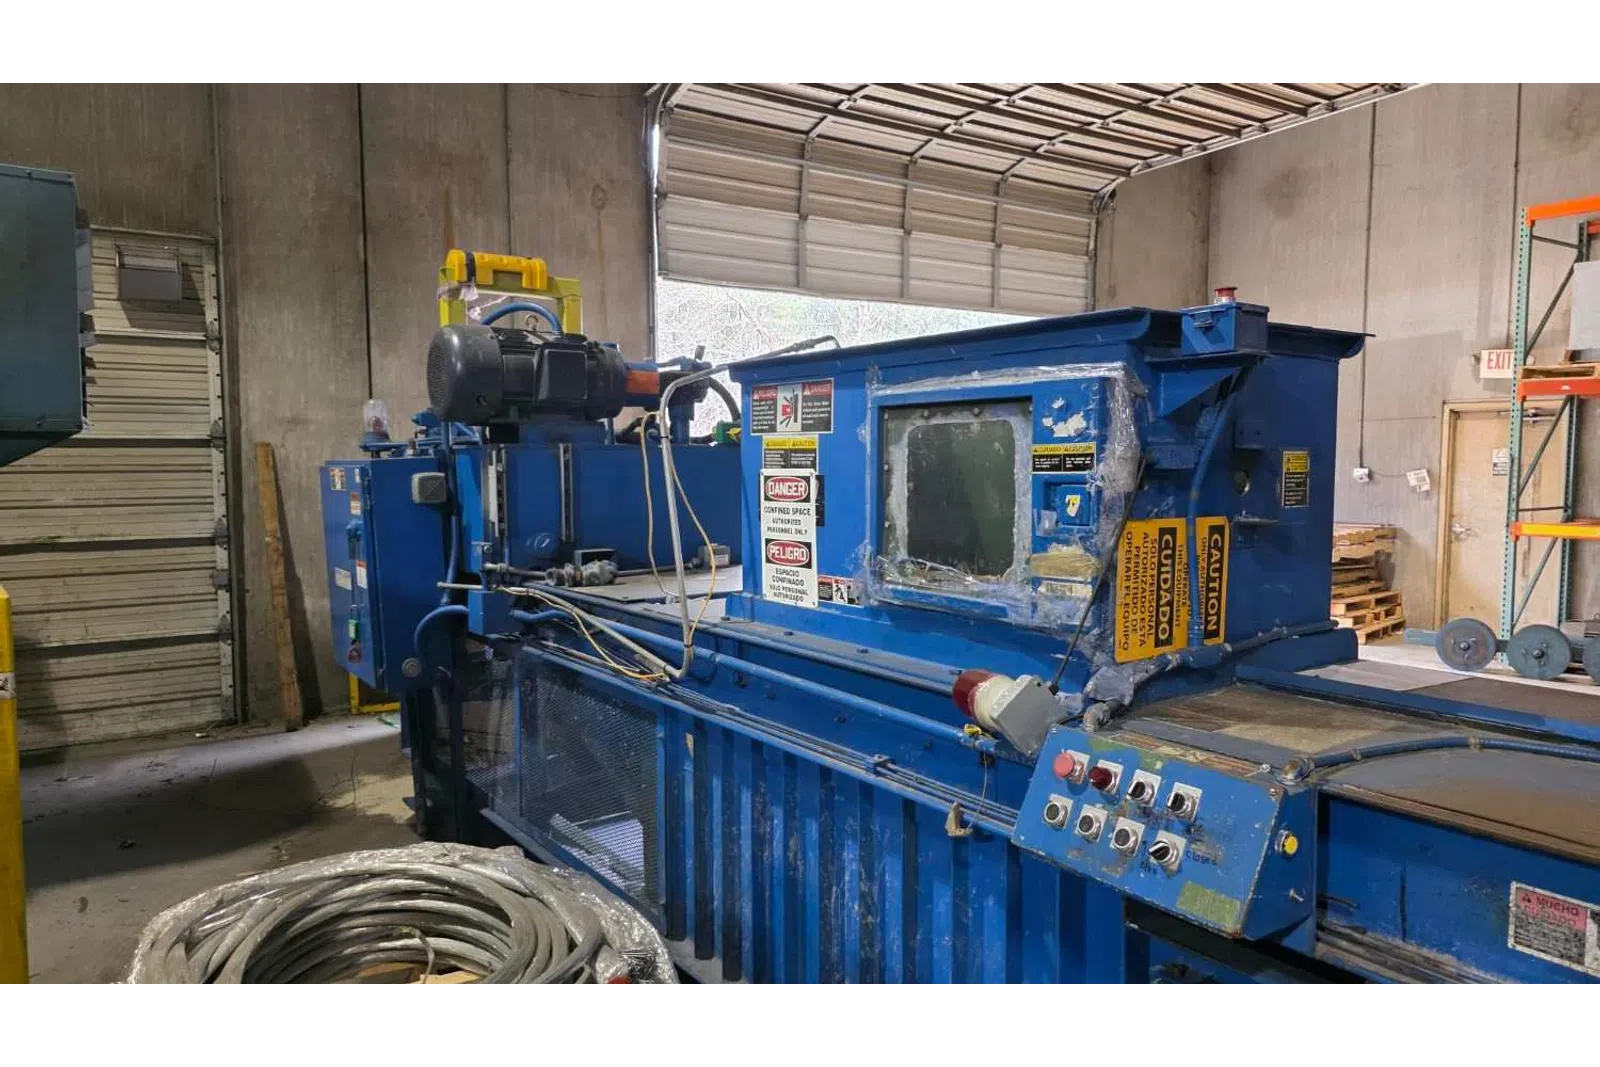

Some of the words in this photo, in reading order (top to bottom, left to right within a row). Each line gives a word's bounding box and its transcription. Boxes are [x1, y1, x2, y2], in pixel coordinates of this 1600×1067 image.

[1487, 351, 1512, 370] EXIT
[767, 482, 806, 497] DANGER
[764, 506, 790, 515] CONFINED
[791, 507, 811, 516] SPACE
[769, 545, 807, 560] PELIGRO
[1124, 531, 1133, 582] OPERAR
[1149, 538, 1157, 570] SOLO
[771, 575, 805, 586] CONFINADO
[775, 568, 800, 577] ESPACIO
[1131, 546, 1140, 615] PERMITIDO
[1140, 532, 1149, 614] AUTORIZADO
[1158, 534, 1173, 640] CUIDADO
[1207, 534, 1222, 630] CAUTION
[1147, 574, 1156, 638] PERSONAL
[1175, 569, 1183, 628] EQUIPMENT
[1122, 602, 1131, 651] EQUIPO
[1131, 618, 1138, 635] DE
[1139, 617, 1147, 647] ESTA
[1536, 896, 1580, 917] MUCHO
